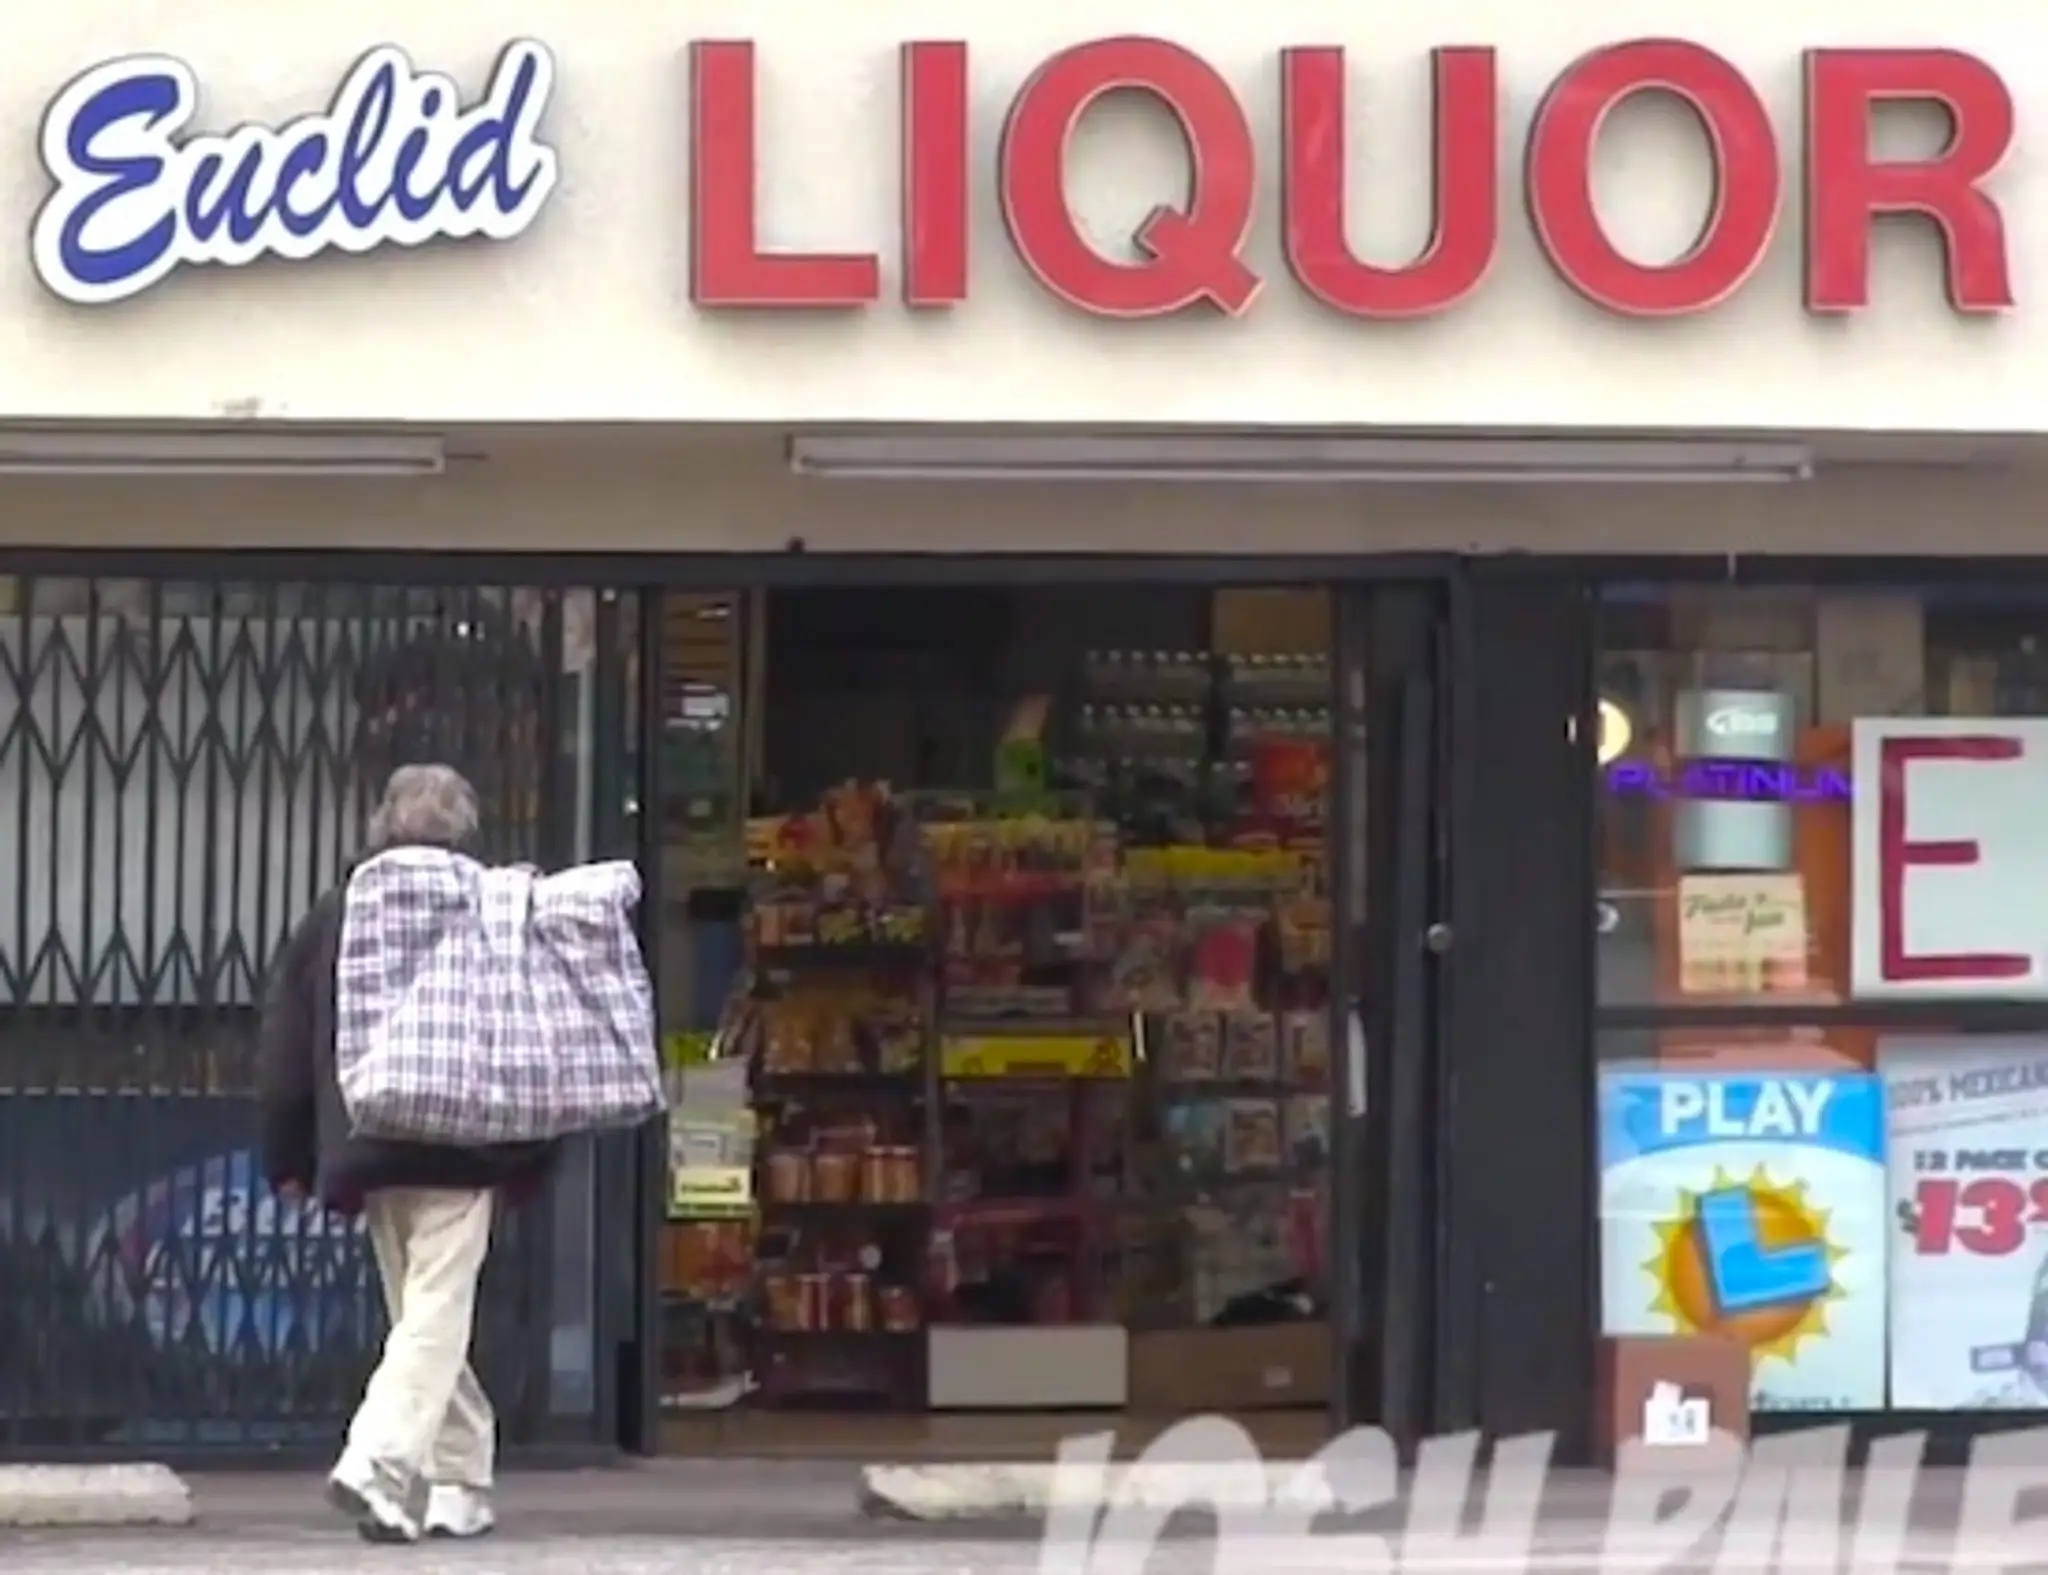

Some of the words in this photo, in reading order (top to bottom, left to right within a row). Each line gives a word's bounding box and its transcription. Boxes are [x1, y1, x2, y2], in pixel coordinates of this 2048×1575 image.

[57, 51, 542, 285] Euclid
[688, 34, 2016, 316] LIQUOR
[1880, 735, 2031, 982] E
[1660, 1078, 1835, 1136] PLAY
[1955, 1149, 2028, 1171] PACK
